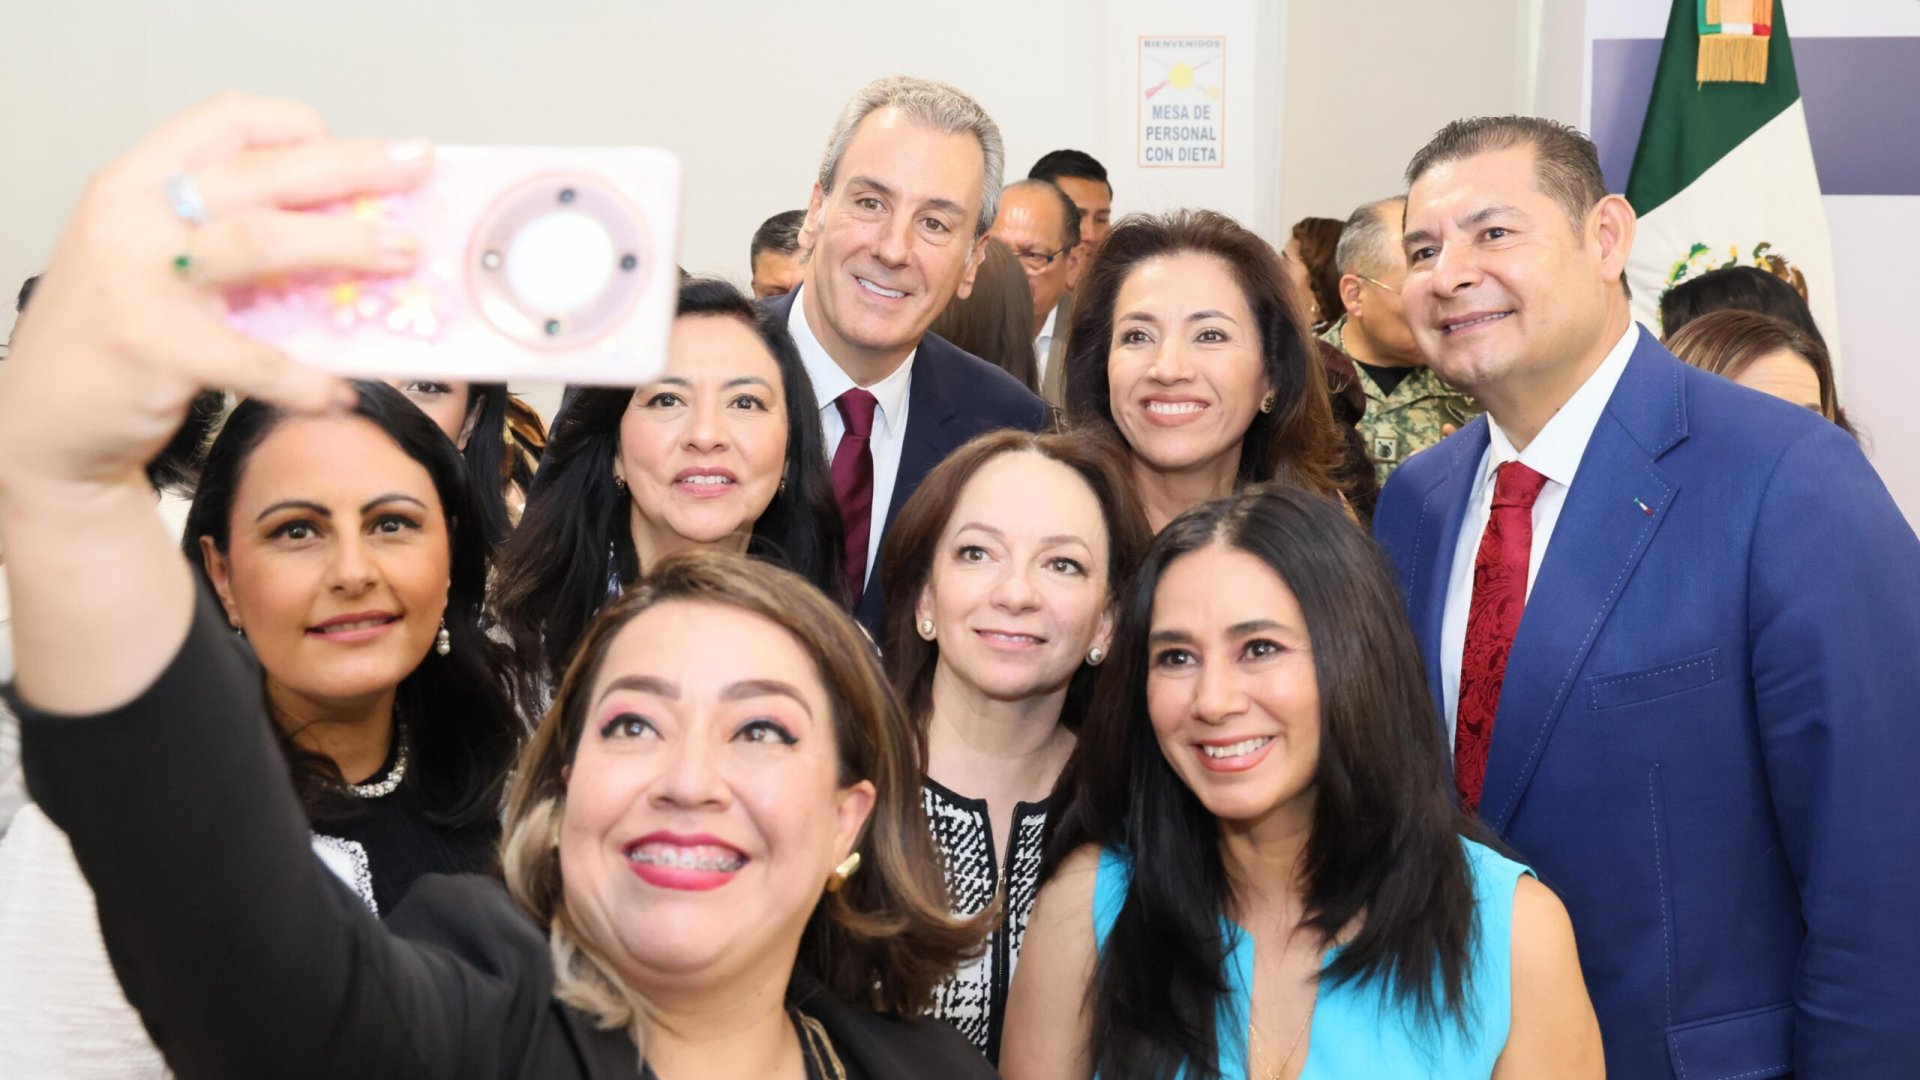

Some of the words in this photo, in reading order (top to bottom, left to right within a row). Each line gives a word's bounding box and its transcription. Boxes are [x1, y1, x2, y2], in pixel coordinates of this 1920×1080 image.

[1144, 40, 1220, 48] BIENVENIDOS
[1152, 105, 1189, 120] MESA
[1194, 105, 1211, 120] DE
[1146, 126, 1217, 141] PERSONAL
[1145, 147, 1173, 162] CON
[1178, 147, 1217, 162] DIETA
